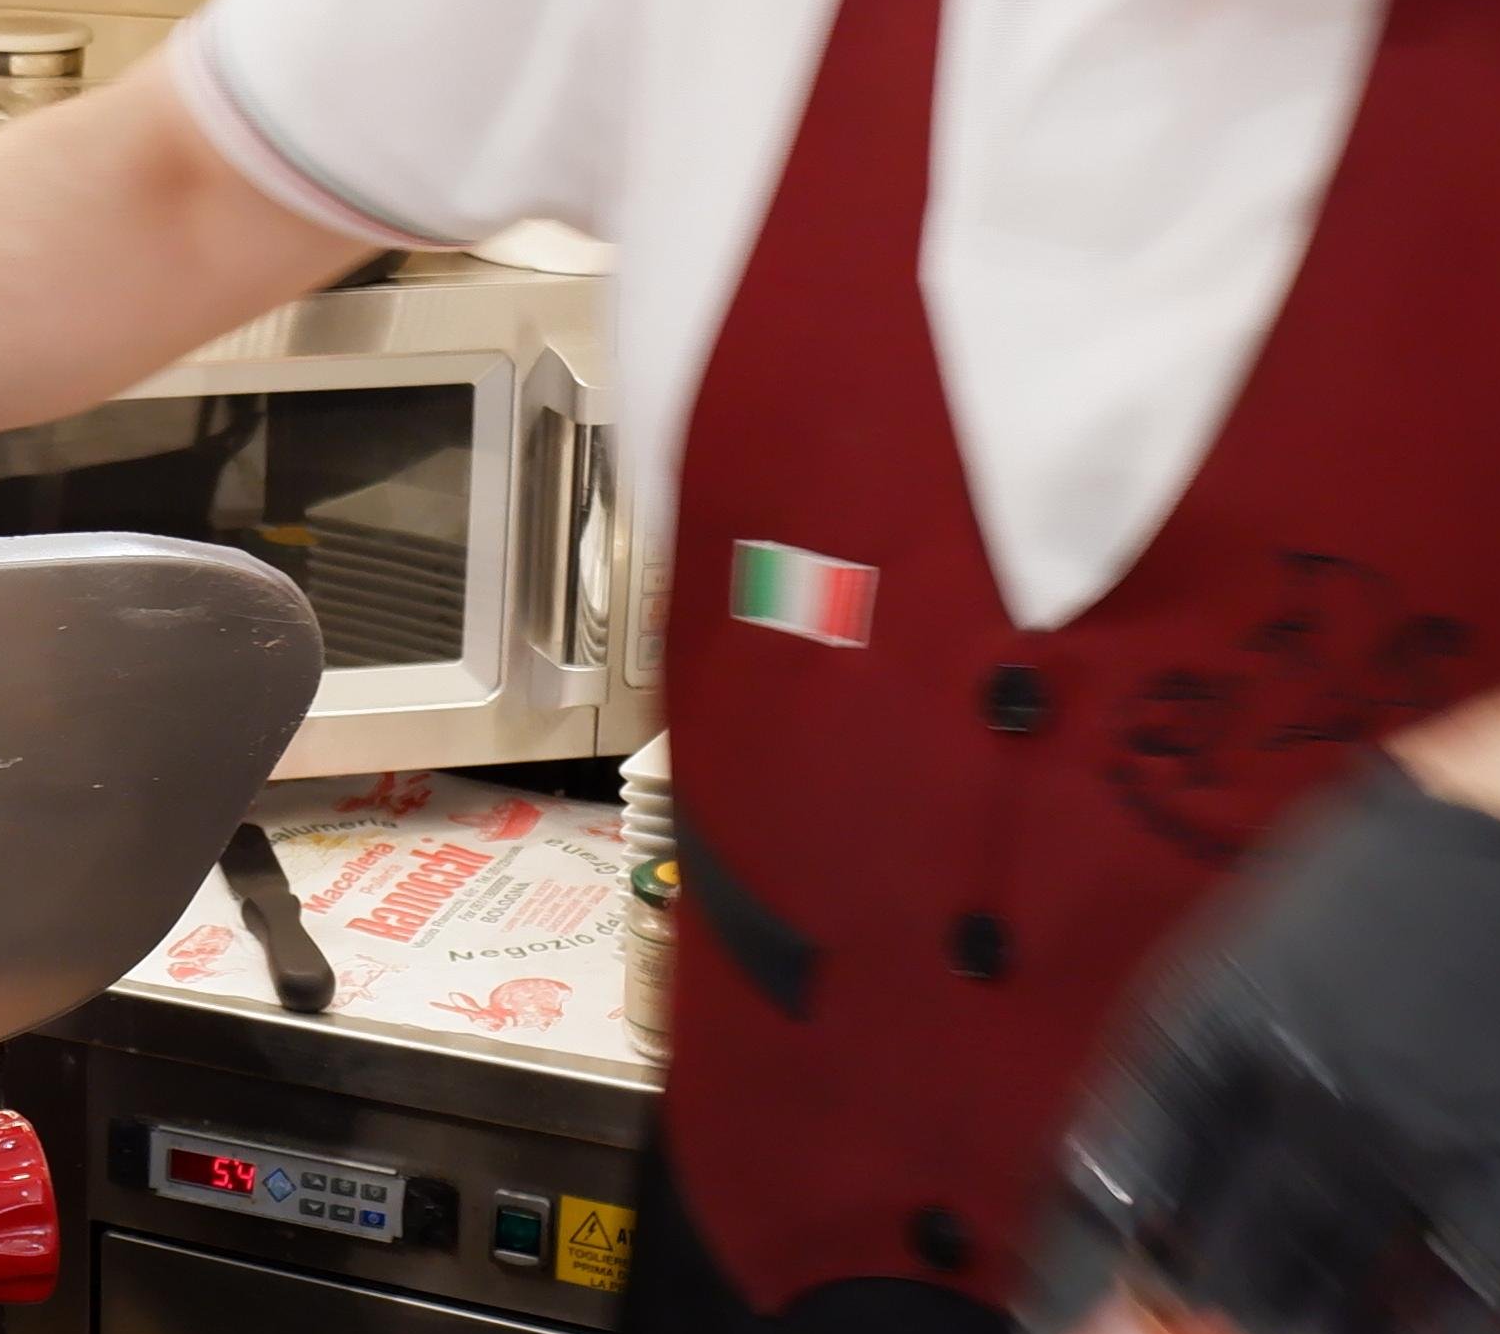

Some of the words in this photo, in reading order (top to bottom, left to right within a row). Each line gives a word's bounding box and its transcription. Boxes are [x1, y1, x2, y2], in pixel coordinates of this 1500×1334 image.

[302, 841, 396, 914] Macelleria
[344, 836, 495, 943] Ranocchi
[449, 933, 595, 963] Negozio
